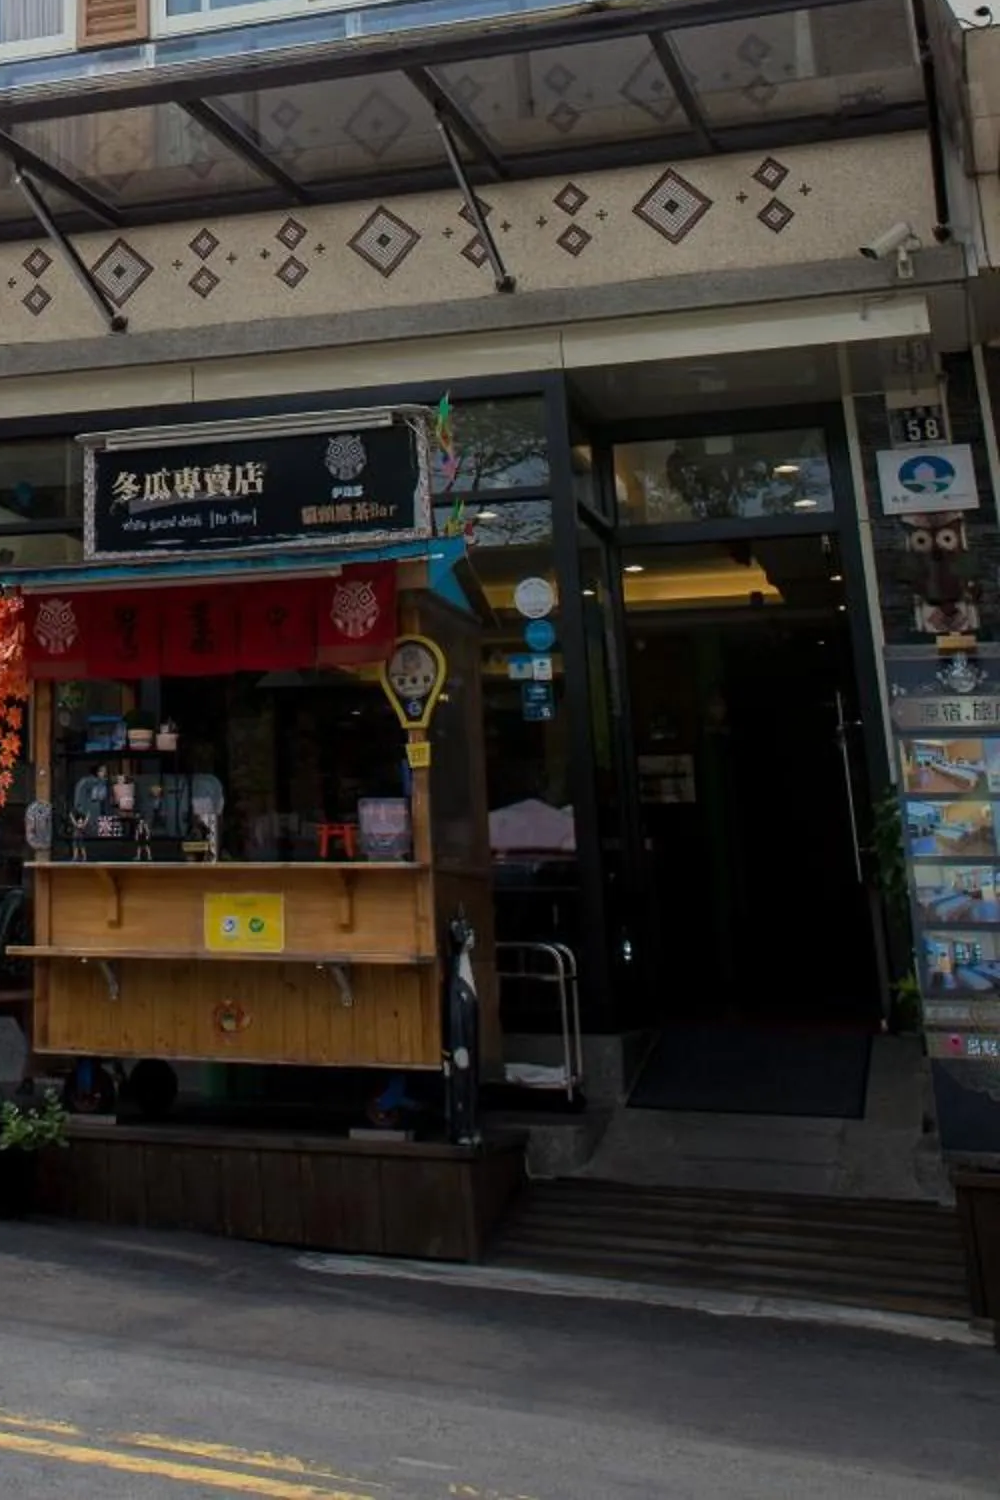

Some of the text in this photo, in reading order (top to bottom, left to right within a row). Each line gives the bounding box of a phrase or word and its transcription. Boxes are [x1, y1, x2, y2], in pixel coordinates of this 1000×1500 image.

[907, 419, 939, 441] 58
[112, 461, 265, 501] 冬瓜專賣店
